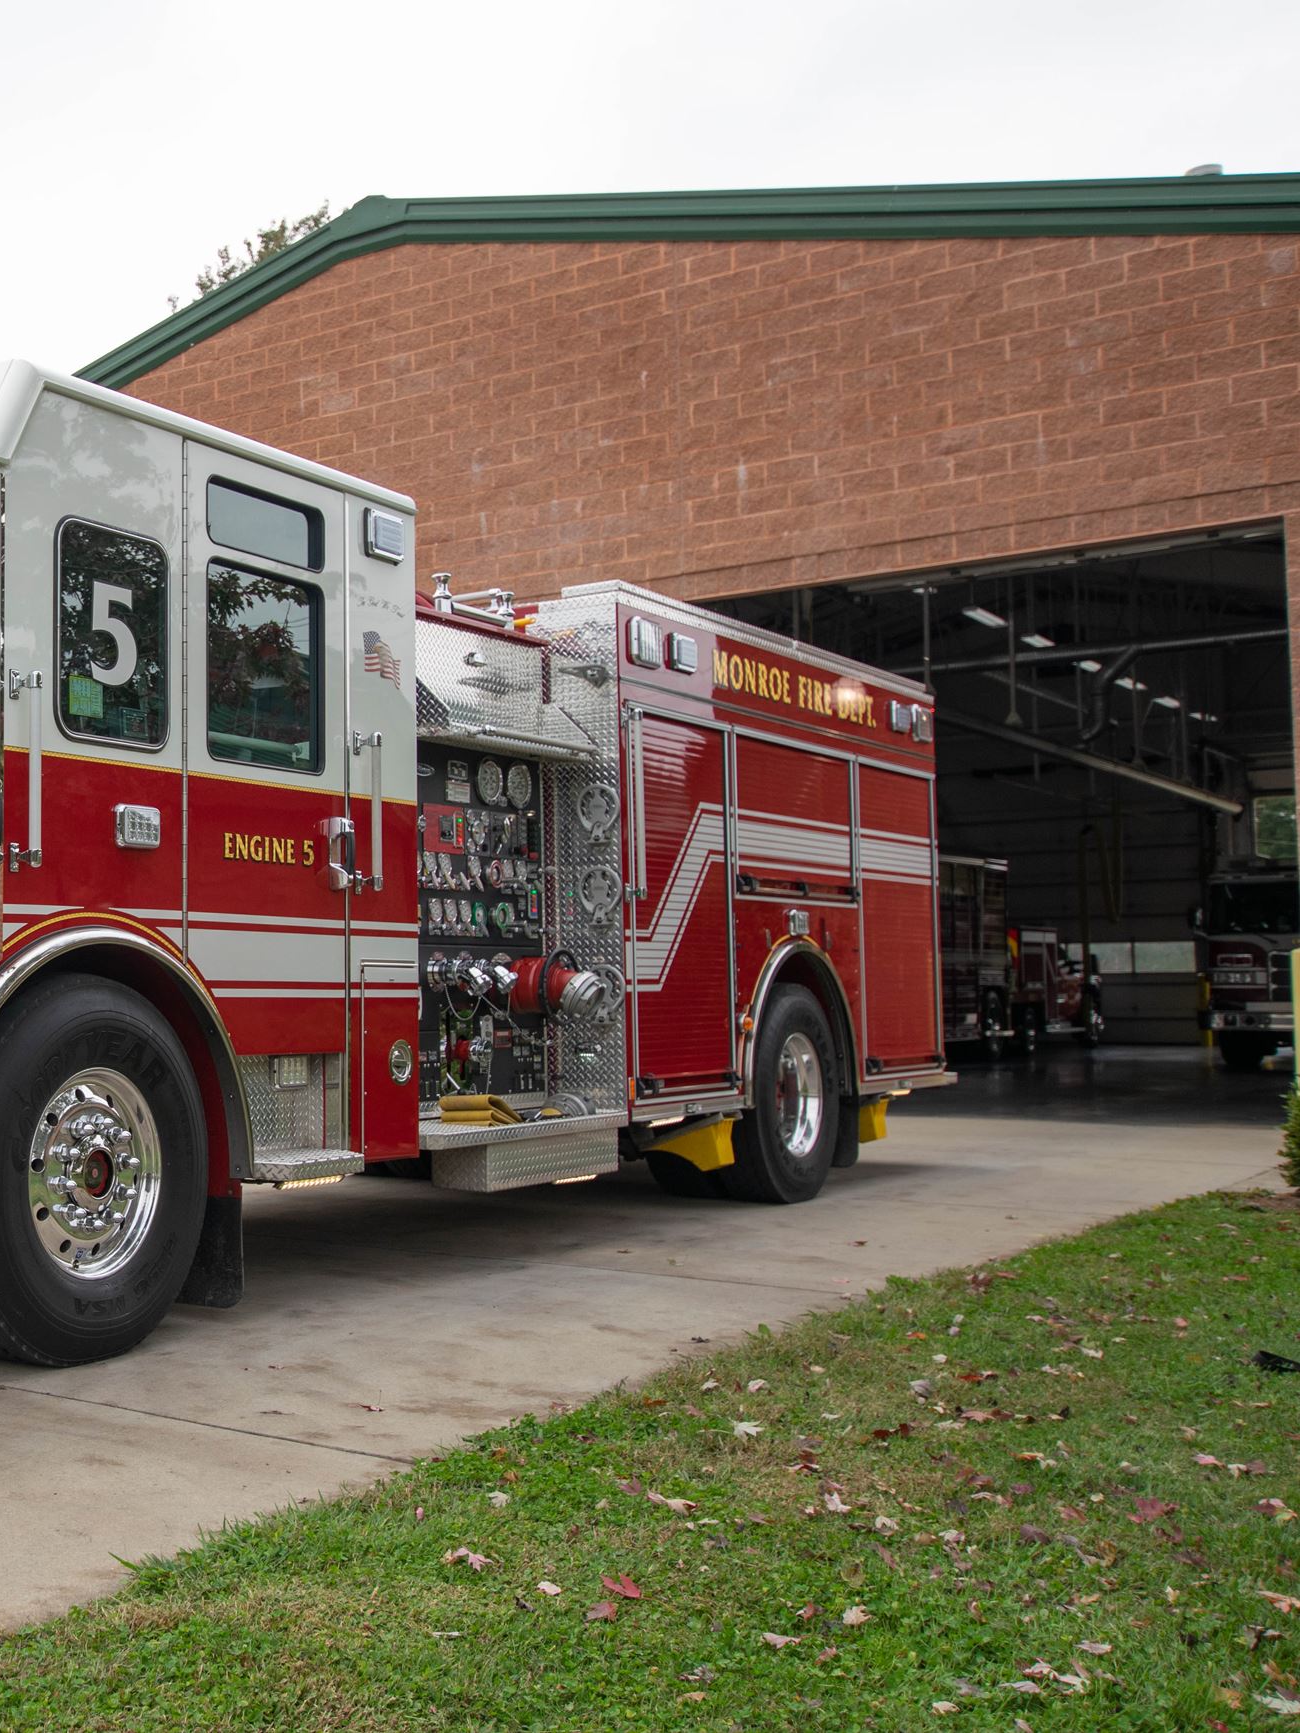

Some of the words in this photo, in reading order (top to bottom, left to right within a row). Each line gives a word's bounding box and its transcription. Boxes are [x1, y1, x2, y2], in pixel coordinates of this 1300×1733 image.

[90, 581, 137, 686] 5
[712, 649, 792, 705] MONROE
[798, 675, 833, 716] FIRE
[224, 832, 296, 865] ENGINE
[303, 840, 315, 867] 5
